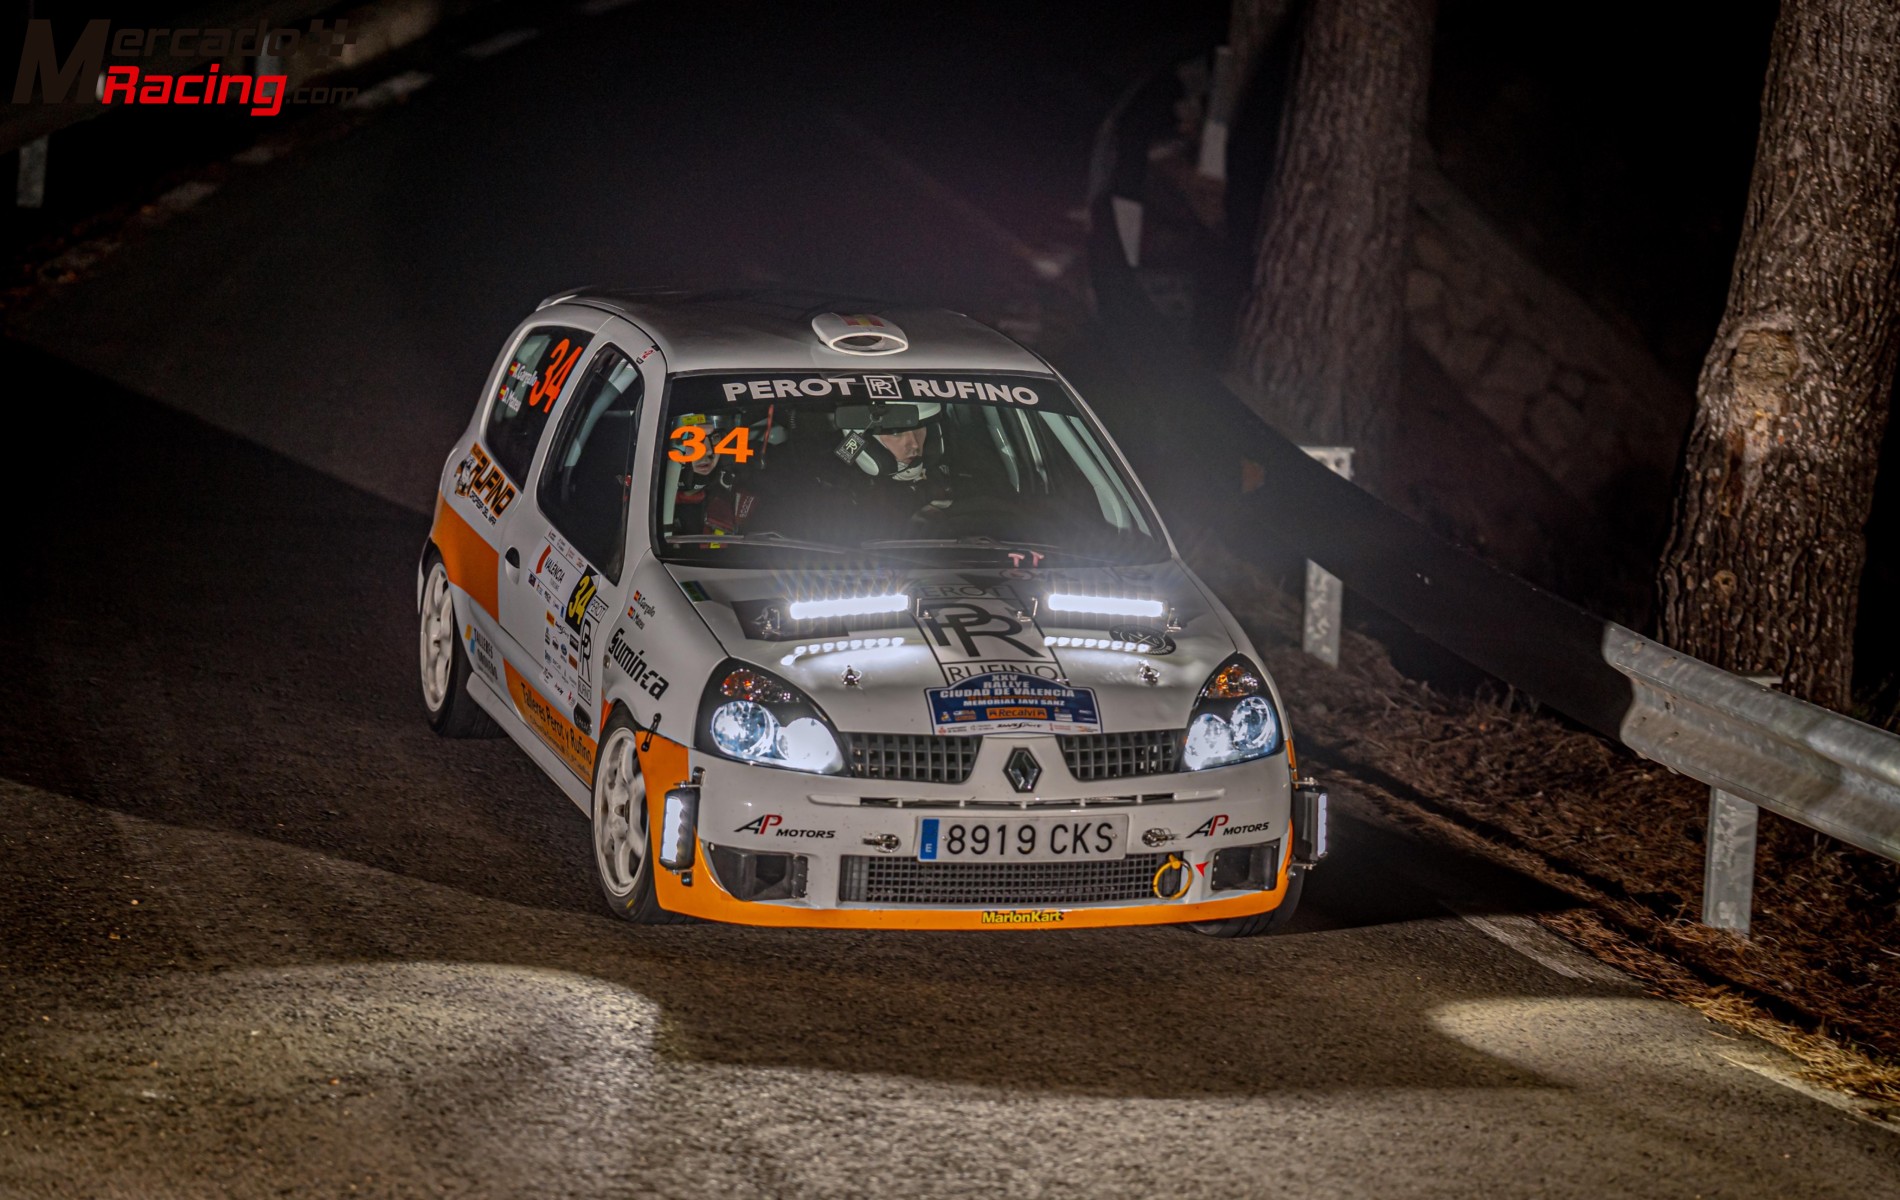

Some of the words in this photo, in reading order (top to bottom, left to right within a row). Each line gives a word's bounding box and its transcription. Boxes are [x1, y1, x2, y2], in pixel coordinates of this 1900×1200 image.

[529, 339, 583, 413] 34
[722, 377, 856, 402] PEROT
[908, 378, 1039, 405] RUFINO
[667, 425, 755, 464] 34
[466, 455, 516, 518] RUFINO
[568, 575, 597, 626] 34
[983, 681, 1030, 689] RALLYE
[991, 674, 1019, 682] XXV
[940, 689, 992, 698] CIUDAD
[993, 688, 1011, 697] DE
[1013, 688, 1076, 697] VALENCIA
[999, 709, 1036, 718] Recalvi
[733, 814, 783, 835] AP
[775, 829, 836, 839] MOTORS
[1186, 814, 1229, 838] AP
[1223, 821, 1270, 836] MOTORS
[925, 844, 932, 853] E
[947, 824, 1036, 856] 8919
[1050, 822, 1113, 855] CKS
[981, 910, 1064, 923] MarlonKart
